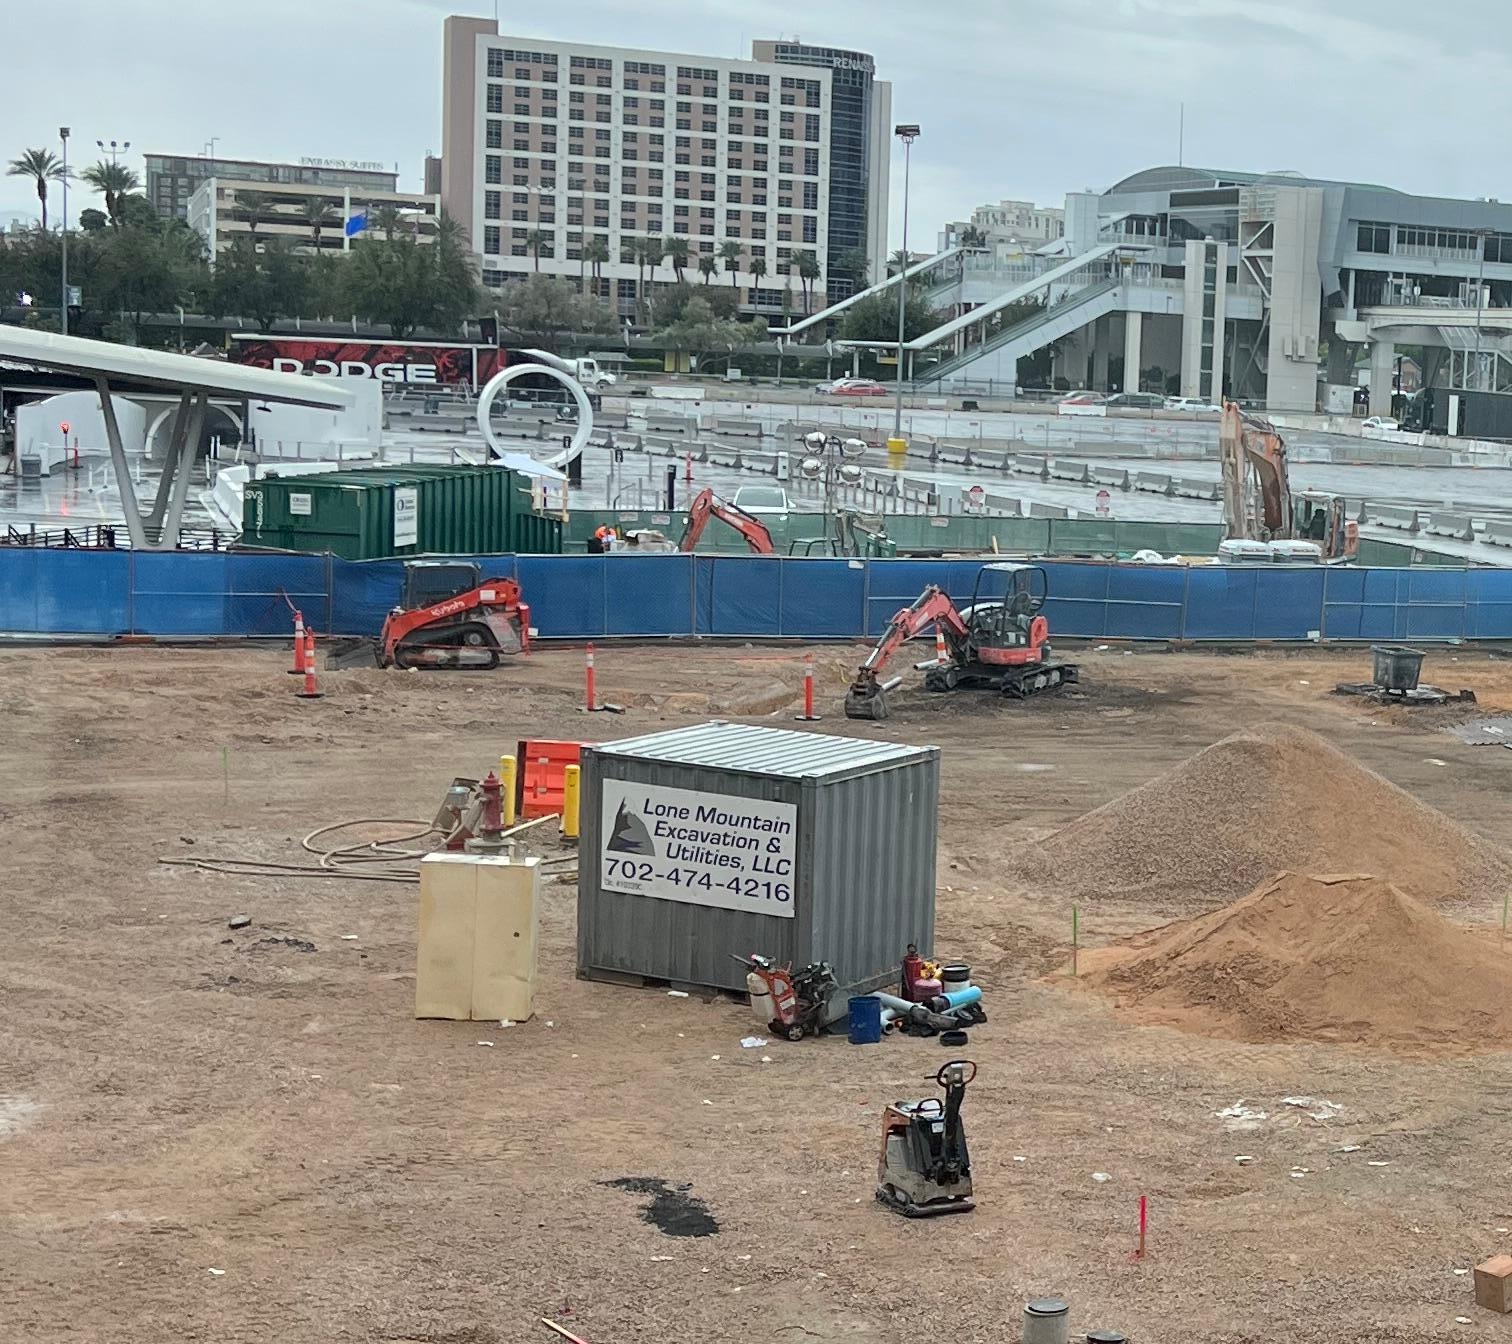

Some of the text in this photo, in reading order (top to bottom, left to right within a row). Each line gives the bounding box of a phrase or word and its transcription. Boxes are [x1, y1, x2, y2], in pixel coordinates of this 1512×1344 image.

[430, 600, 466, 617] Kubota
[643, 797, 791, 835] Lone Mountain
[653, 820, 782, 854] Excavation &
[665, 842, 792, 876] Utilities, LLC
[604, 858, 791, 902] 702-474-4216
